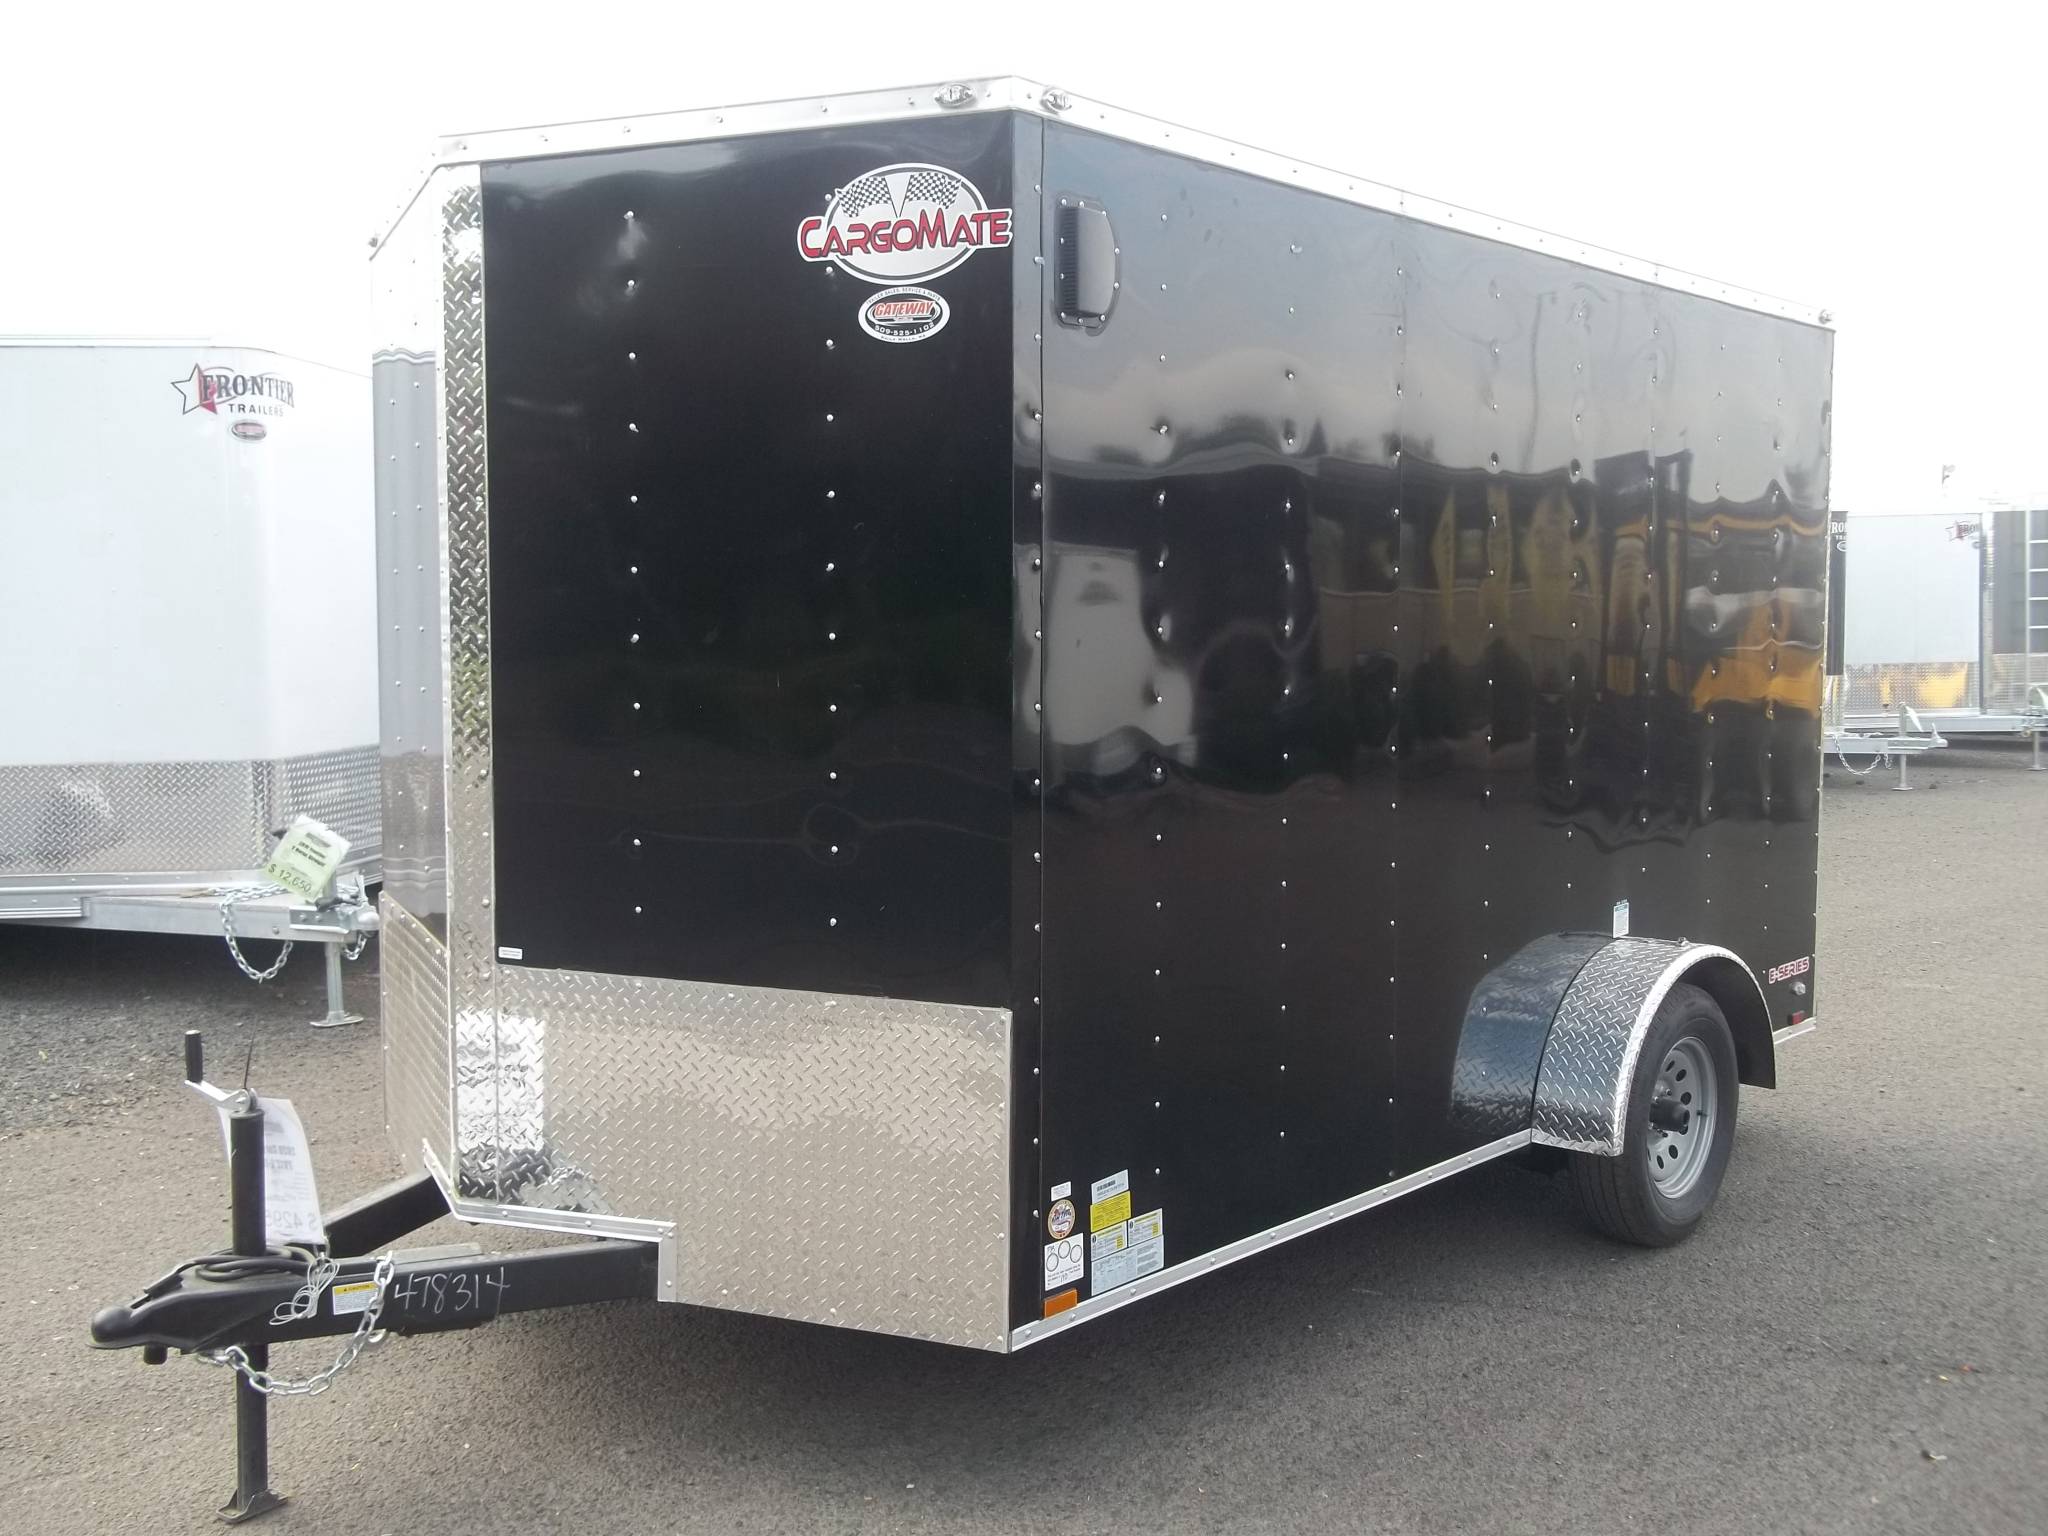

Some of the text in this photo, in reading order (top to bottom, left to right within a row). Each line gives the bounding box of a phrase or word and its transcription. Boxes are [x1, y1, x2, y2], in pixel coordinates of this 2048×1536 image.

[875, 301, 935, 316] GATEWAY
[202, 374, 296, 409] FRONTIER
[228, 403, 285, 418] TRAILERS
[1768, 956, 1810, 985] E-SERIES
[395, 1266, 511, 1314] 478314
